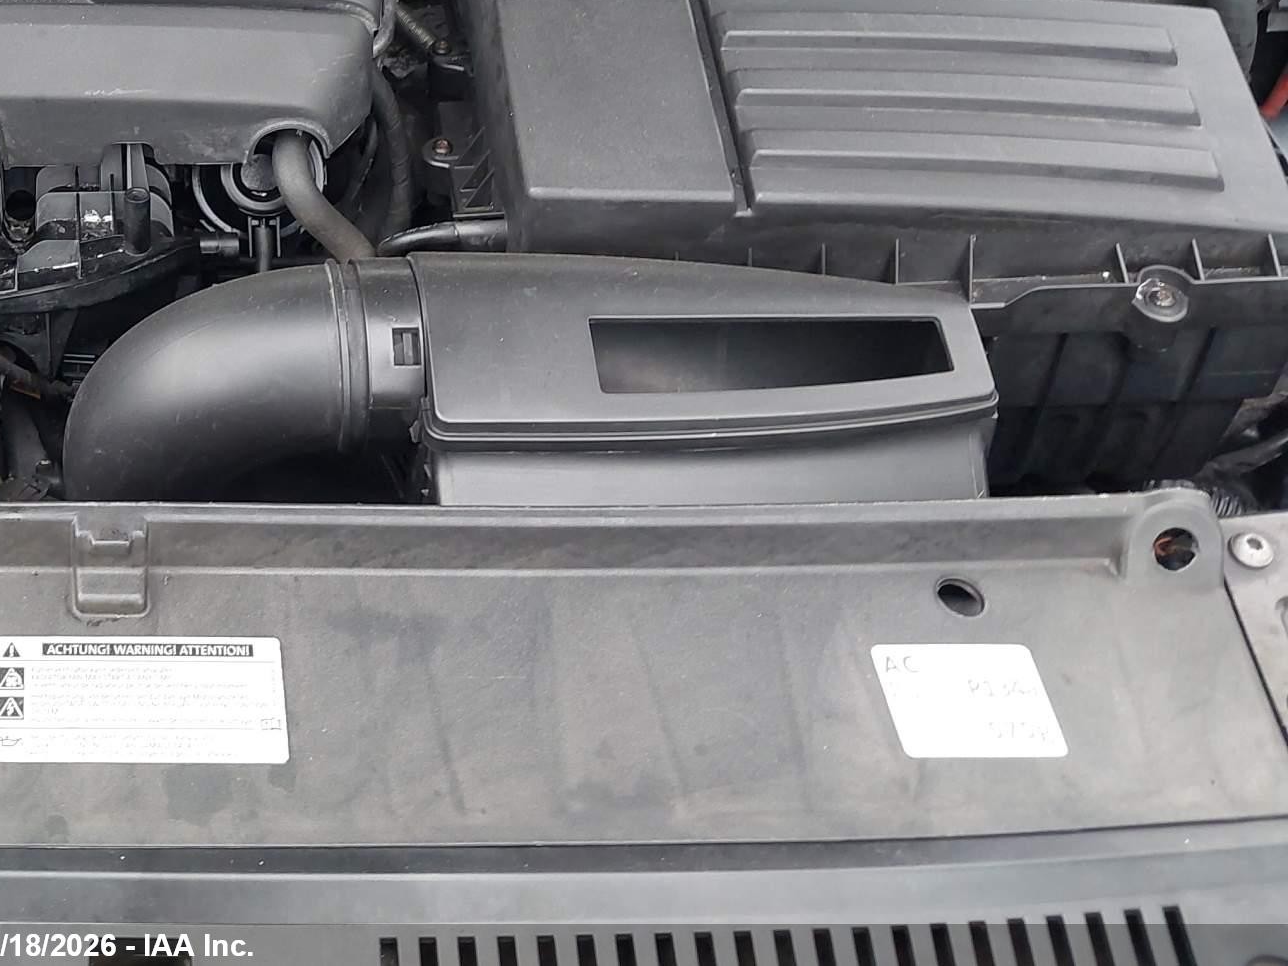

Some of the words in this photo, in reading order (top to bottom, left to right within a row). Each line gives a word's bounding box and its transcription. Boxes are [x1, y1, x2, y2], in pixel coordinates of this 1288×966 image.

[46, 645, 111, 656] ACHTUNG!
[112, 645, 177, 656] WARNING!
[179, 645, 250, 657] ATTENTION!
